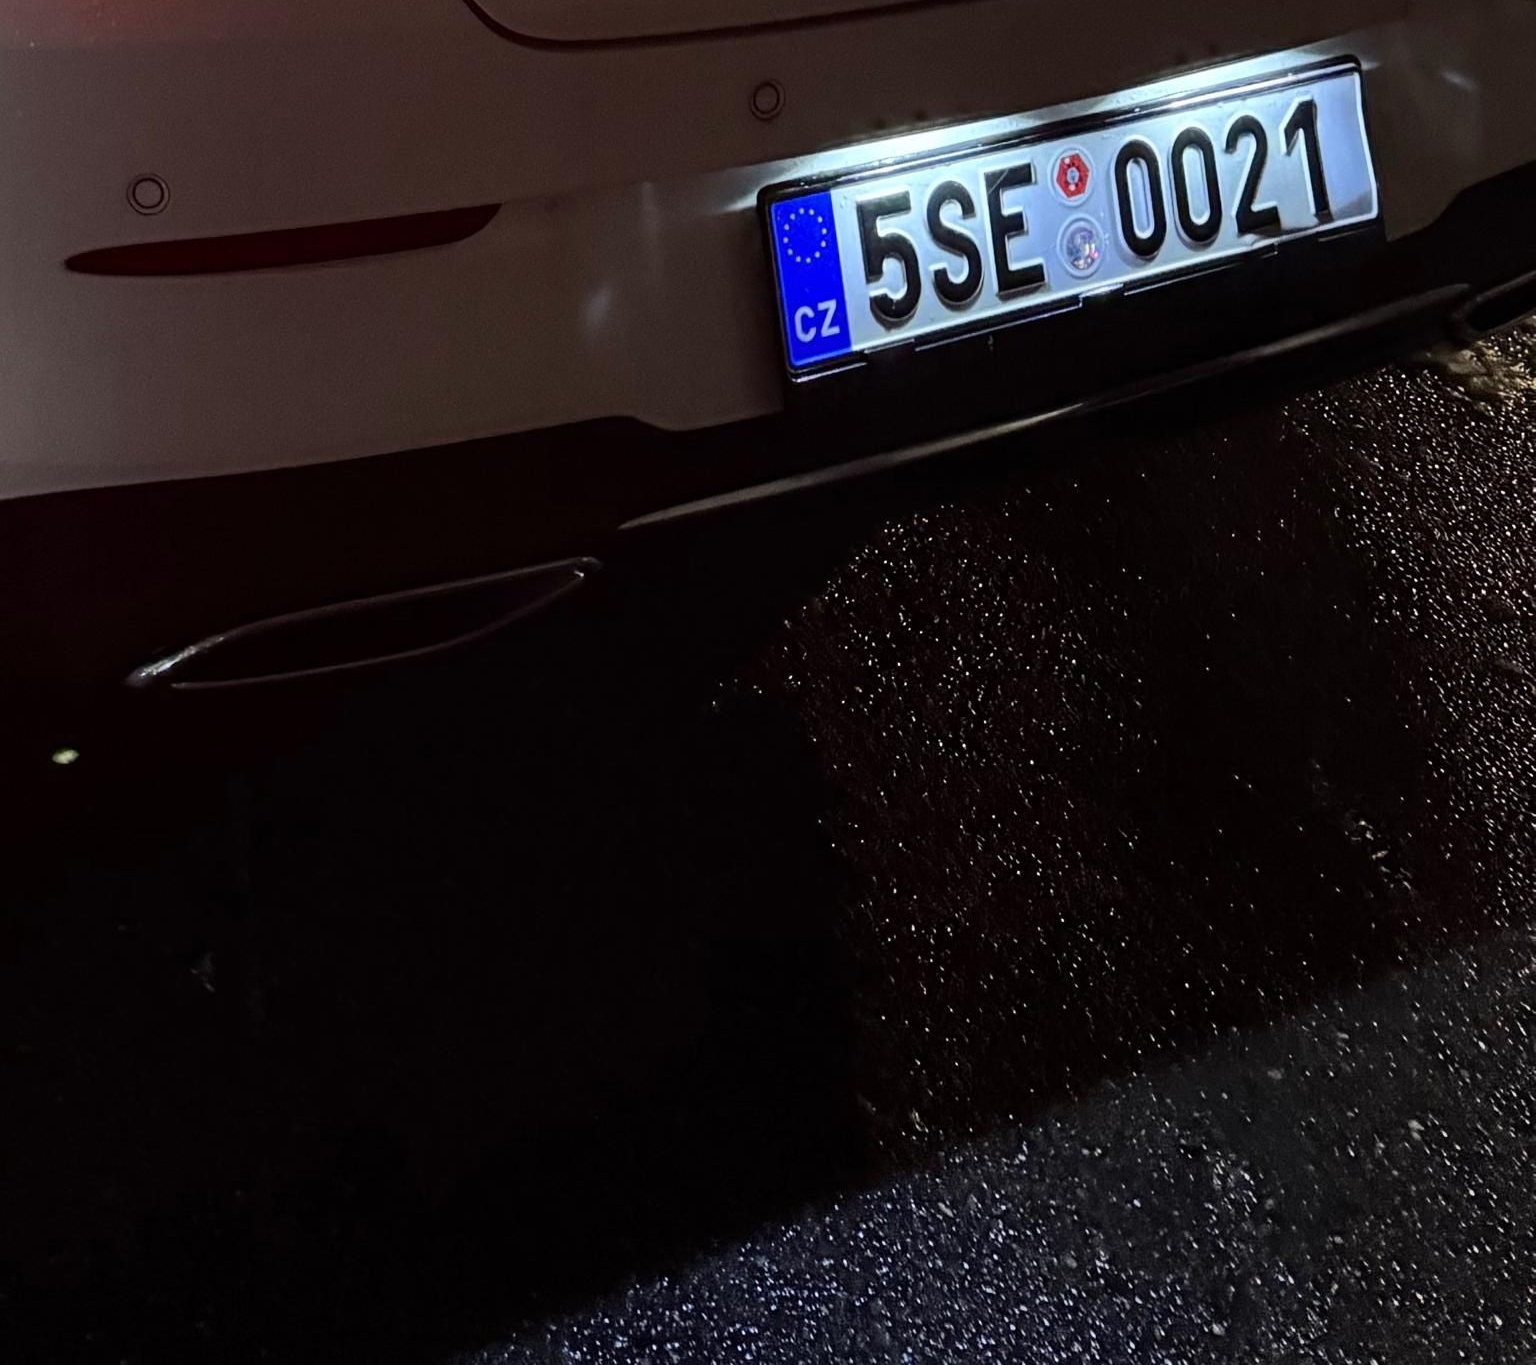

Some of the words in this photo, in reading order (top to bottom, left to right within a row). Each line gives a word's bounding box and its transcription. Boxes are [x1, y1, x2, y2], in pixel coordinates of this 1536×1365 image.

[856, 162, 1046, 324] 5SE
[1114, 97, 1331, 260] 0021
[794, 300, 841, 344] CZ
